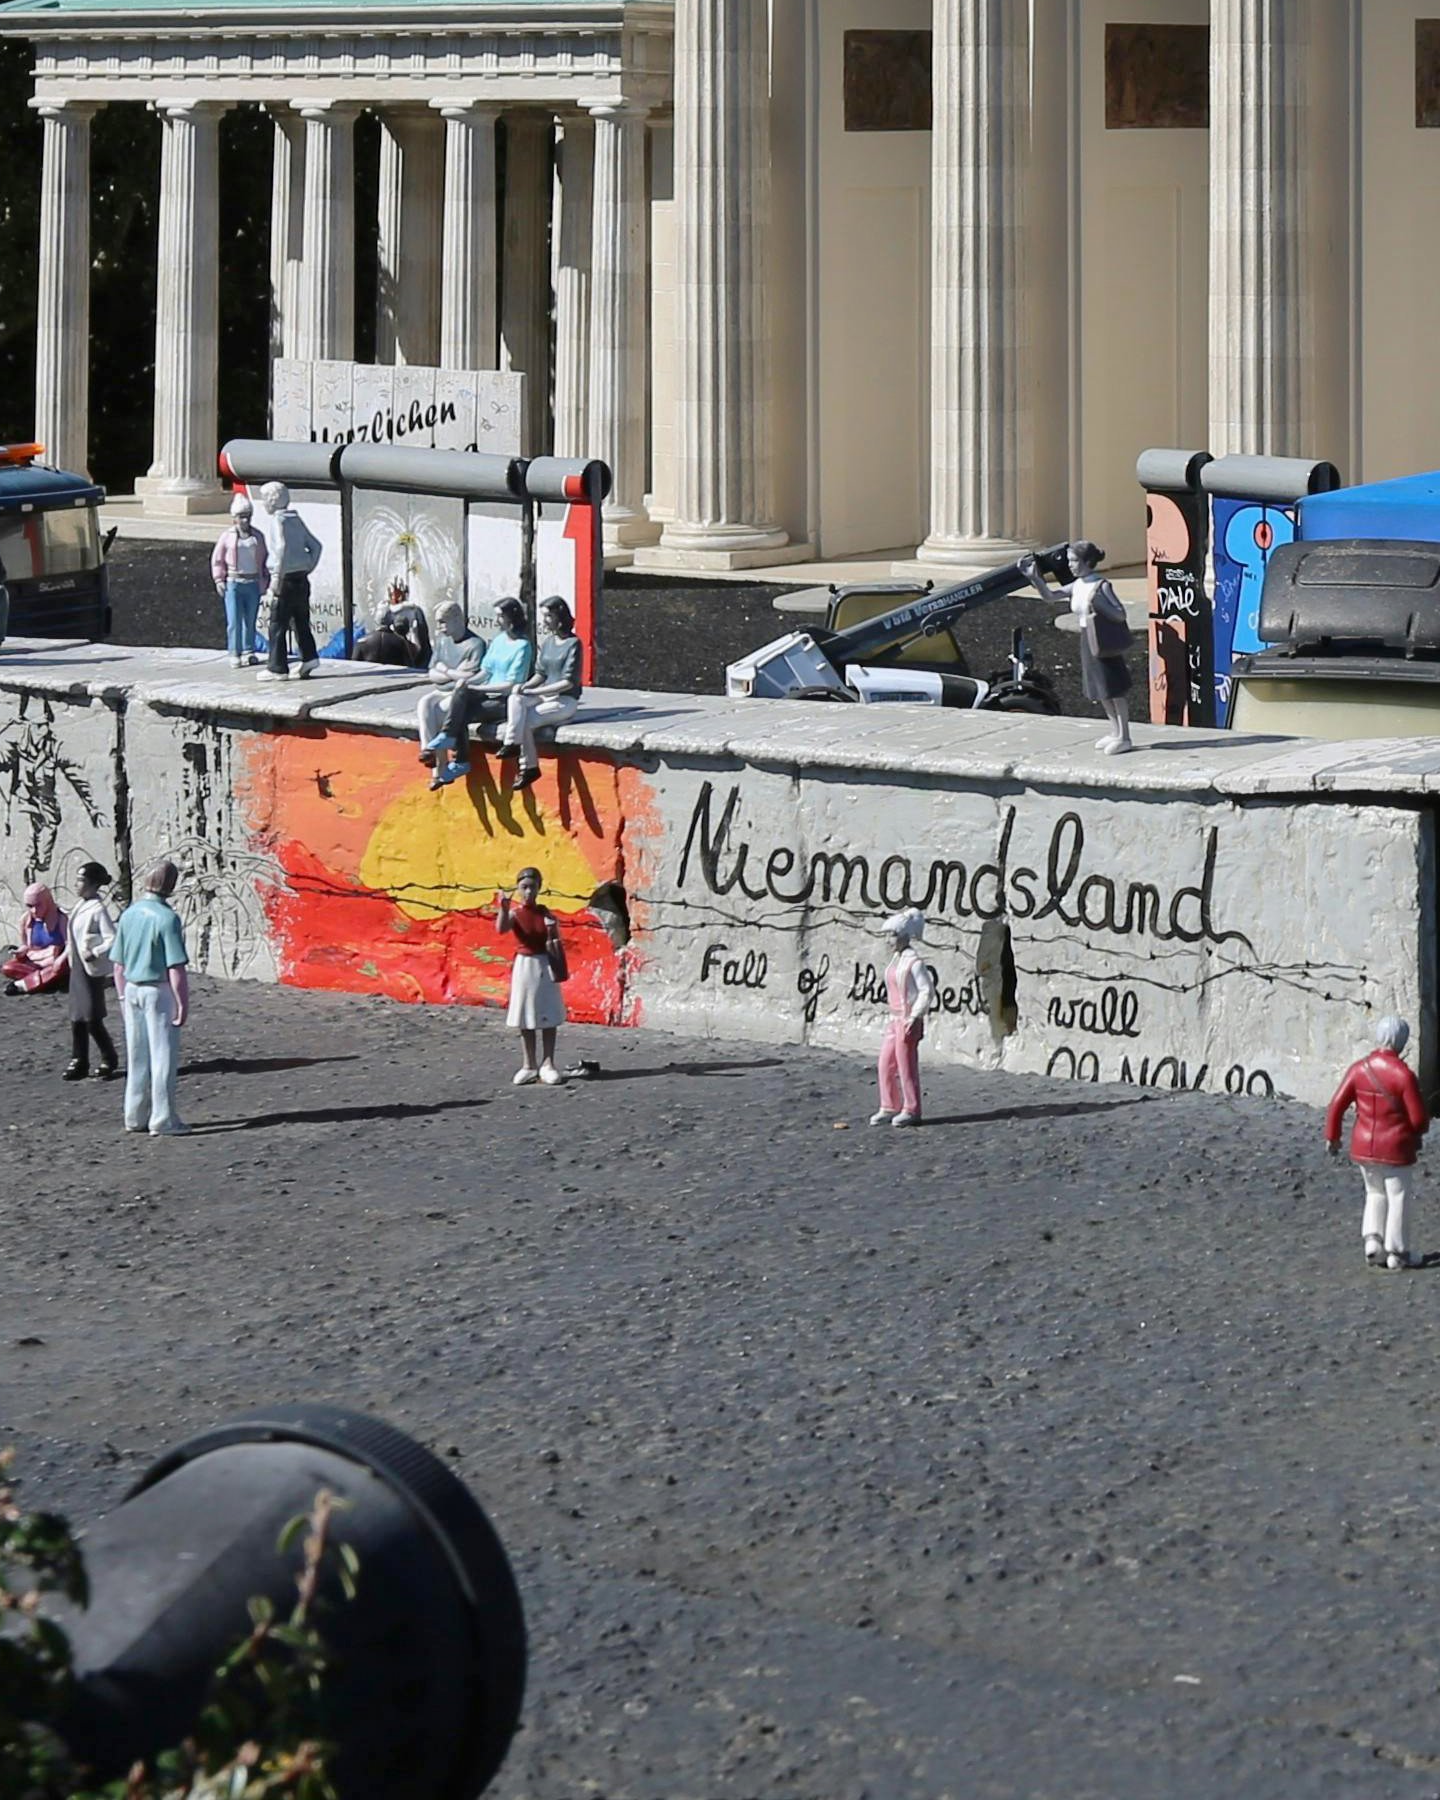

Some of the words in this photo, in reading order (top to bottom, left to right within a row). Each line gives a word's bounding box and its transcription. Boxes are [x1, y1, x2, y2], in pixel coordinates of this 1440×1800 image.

[676, 781, 1259, 962] Niemandsland
[701, 943, 768, 989] Fall
[797, 953, 830, 1022] of
[1047, 986, 1141, 1038] wall
